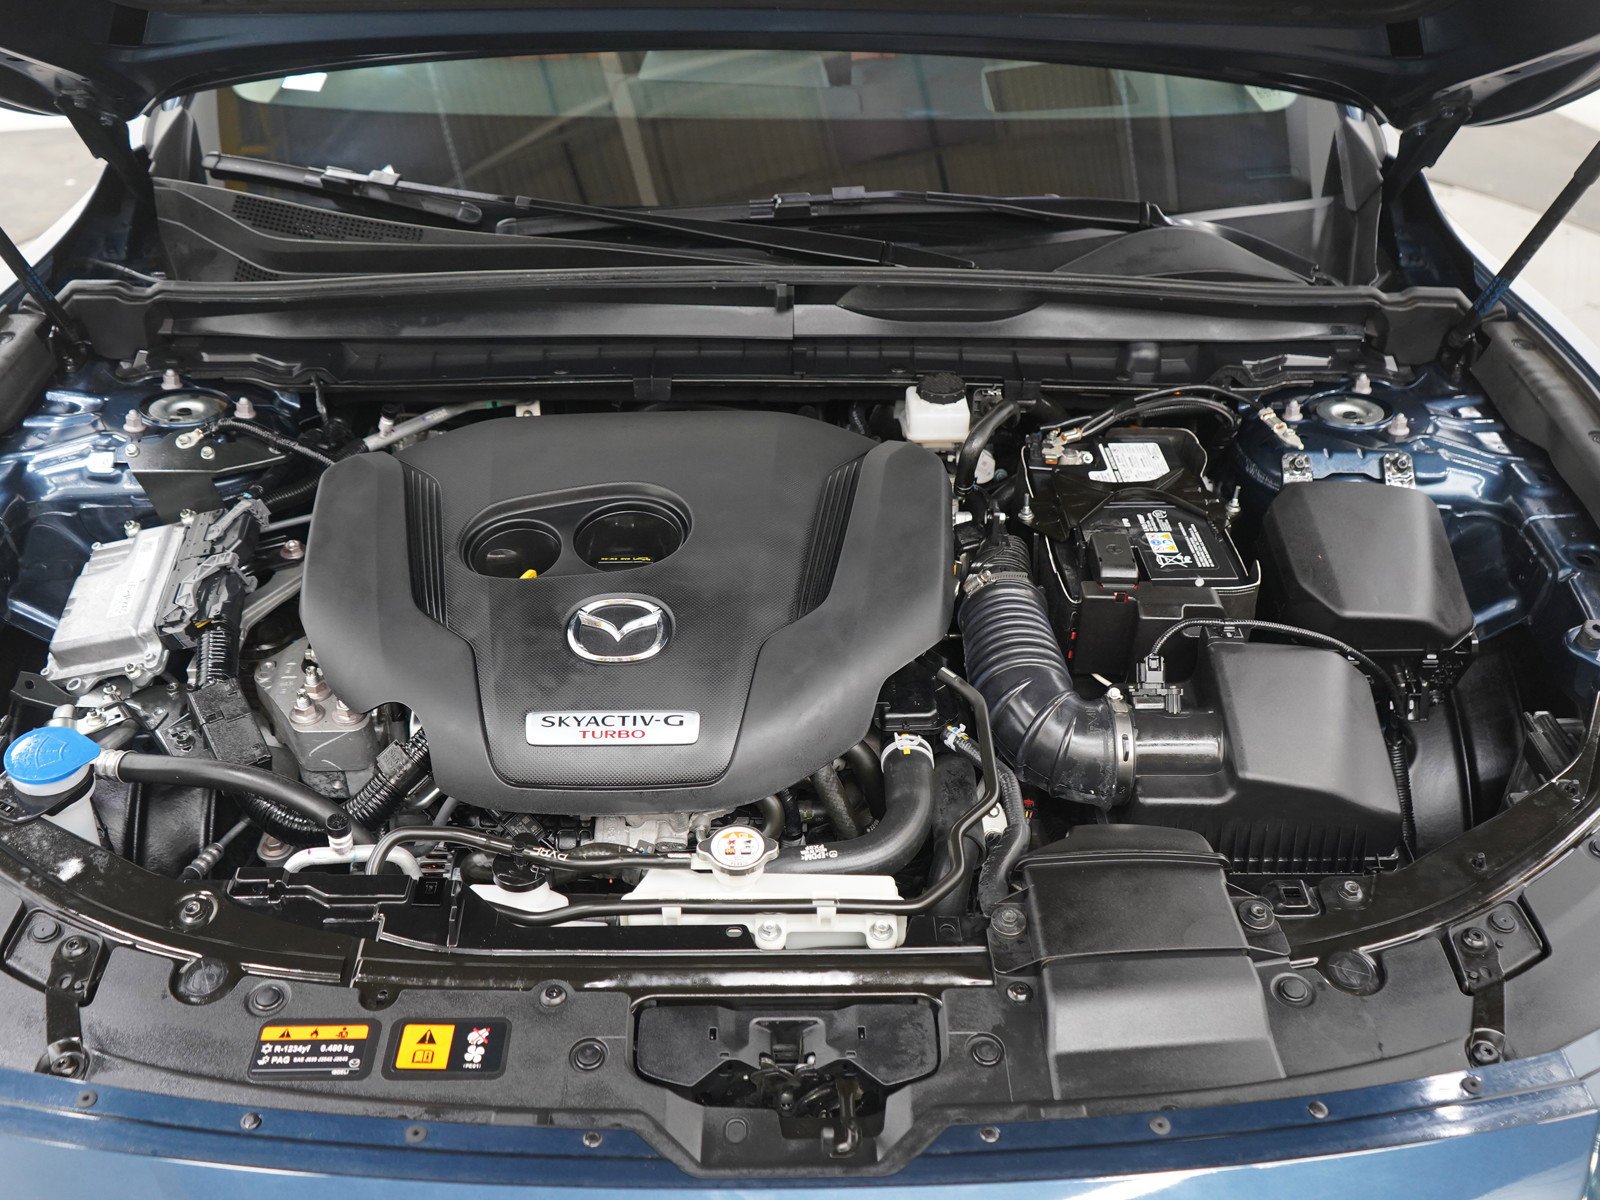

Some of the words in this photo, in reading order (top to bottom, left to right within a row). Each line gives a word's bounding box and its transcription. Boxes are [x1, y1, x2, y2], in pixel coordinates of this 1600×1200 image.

[541, 714, 684, 728] SKYACTIV-G
[579, 730, 646, 739] TURBO
[274, 1044, 312, 1054] R-1234yf
[343, 1044, 355, 1054] kg
[271, 1055, 290, 1064] PAG
